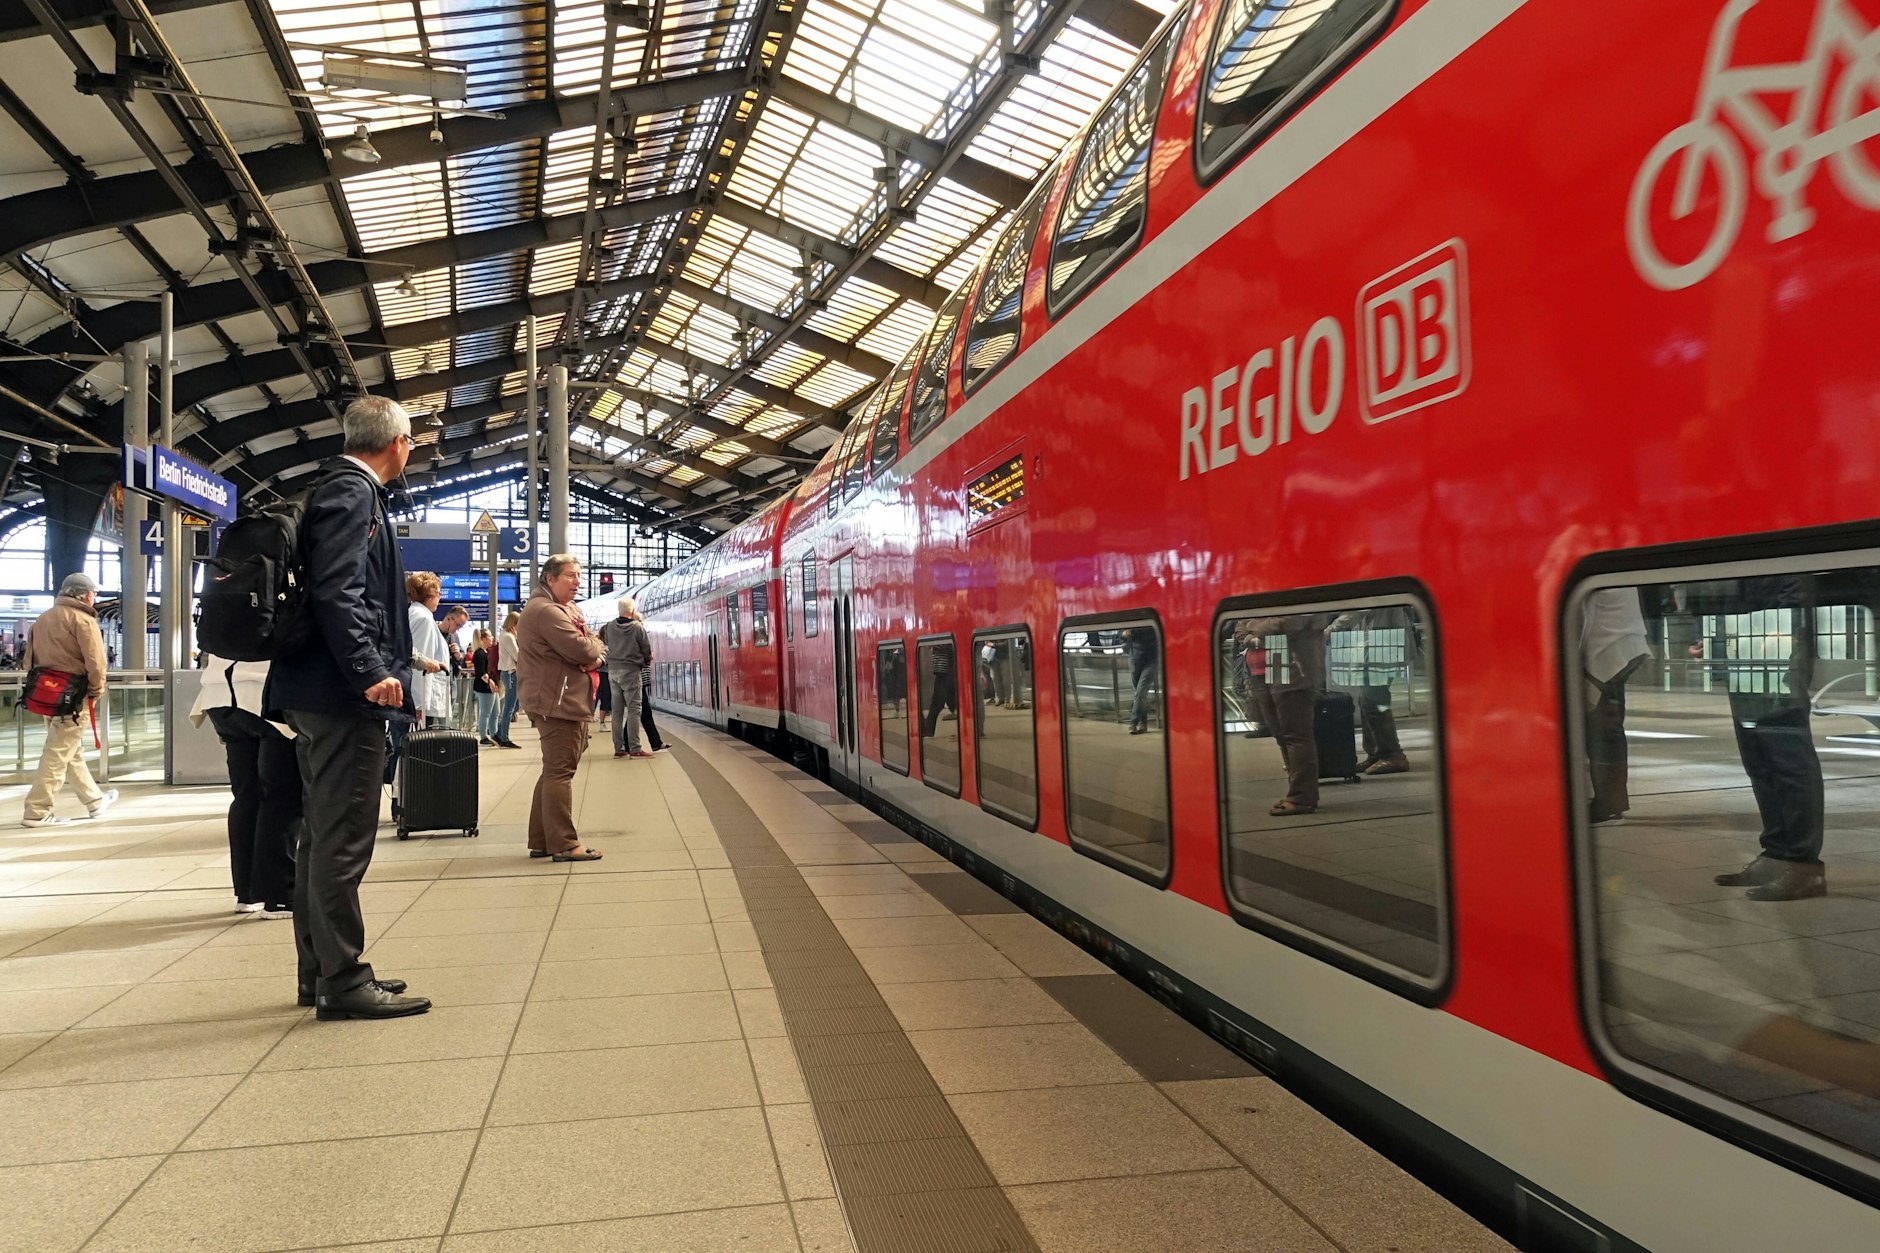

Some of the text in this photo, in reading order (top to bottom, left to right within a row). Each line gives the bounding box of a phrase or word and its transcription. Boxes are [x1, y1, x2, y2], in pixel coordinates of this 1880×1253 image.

[1179, 315, 1345, 482] REGIO
[159, 455, 228, 507] Berlin Friedrichstraße
[145, 521, 164, 548] 4
[513, 528, 530, 553] 3
